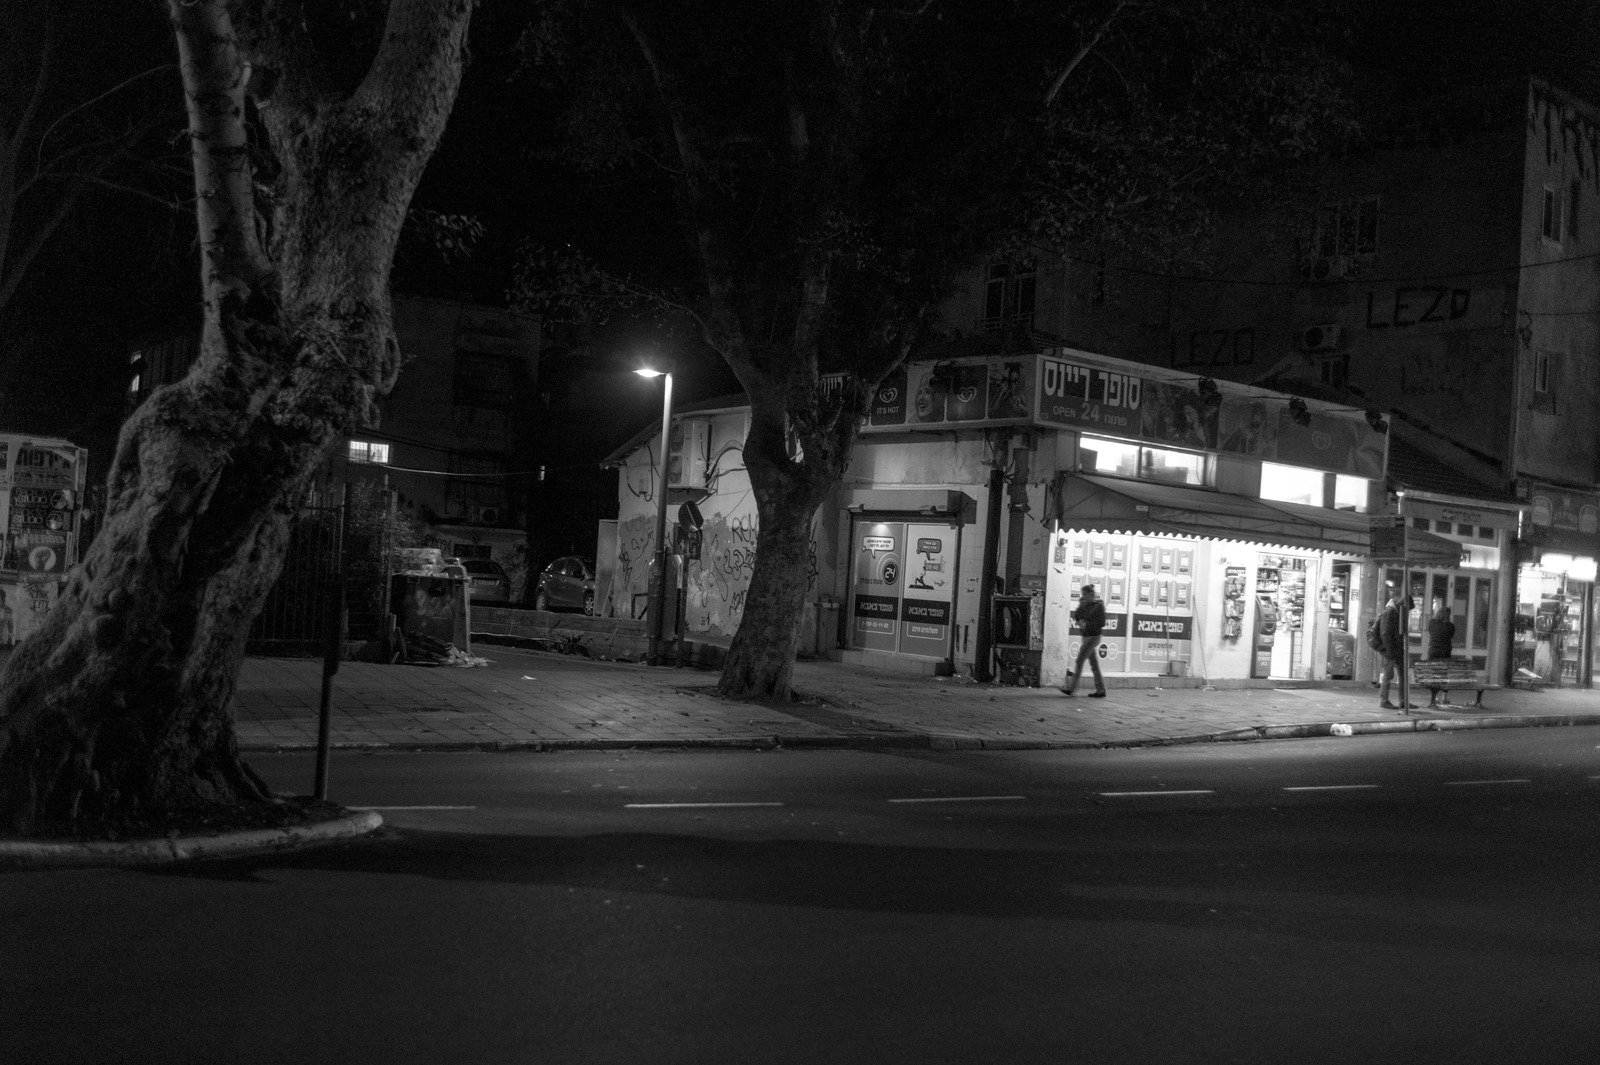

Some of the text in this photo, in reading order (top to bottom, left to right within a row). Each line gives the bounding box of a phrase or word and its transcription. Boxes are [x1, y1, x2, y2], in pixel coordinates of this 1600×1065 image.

[1098, 371, 1141, 410] סופר
[1053, 405, 1076, 418] OPEN
[1081, 402, 1100, 422] 24
[1104, 414, 1127, 426] פתוח
[1056, 549, 1065, 560] 39
[884, 567, 896, 579] 24
[908, 606, 944, 618] סופר באבא
[1137, 620, 1163, 633] באבא
